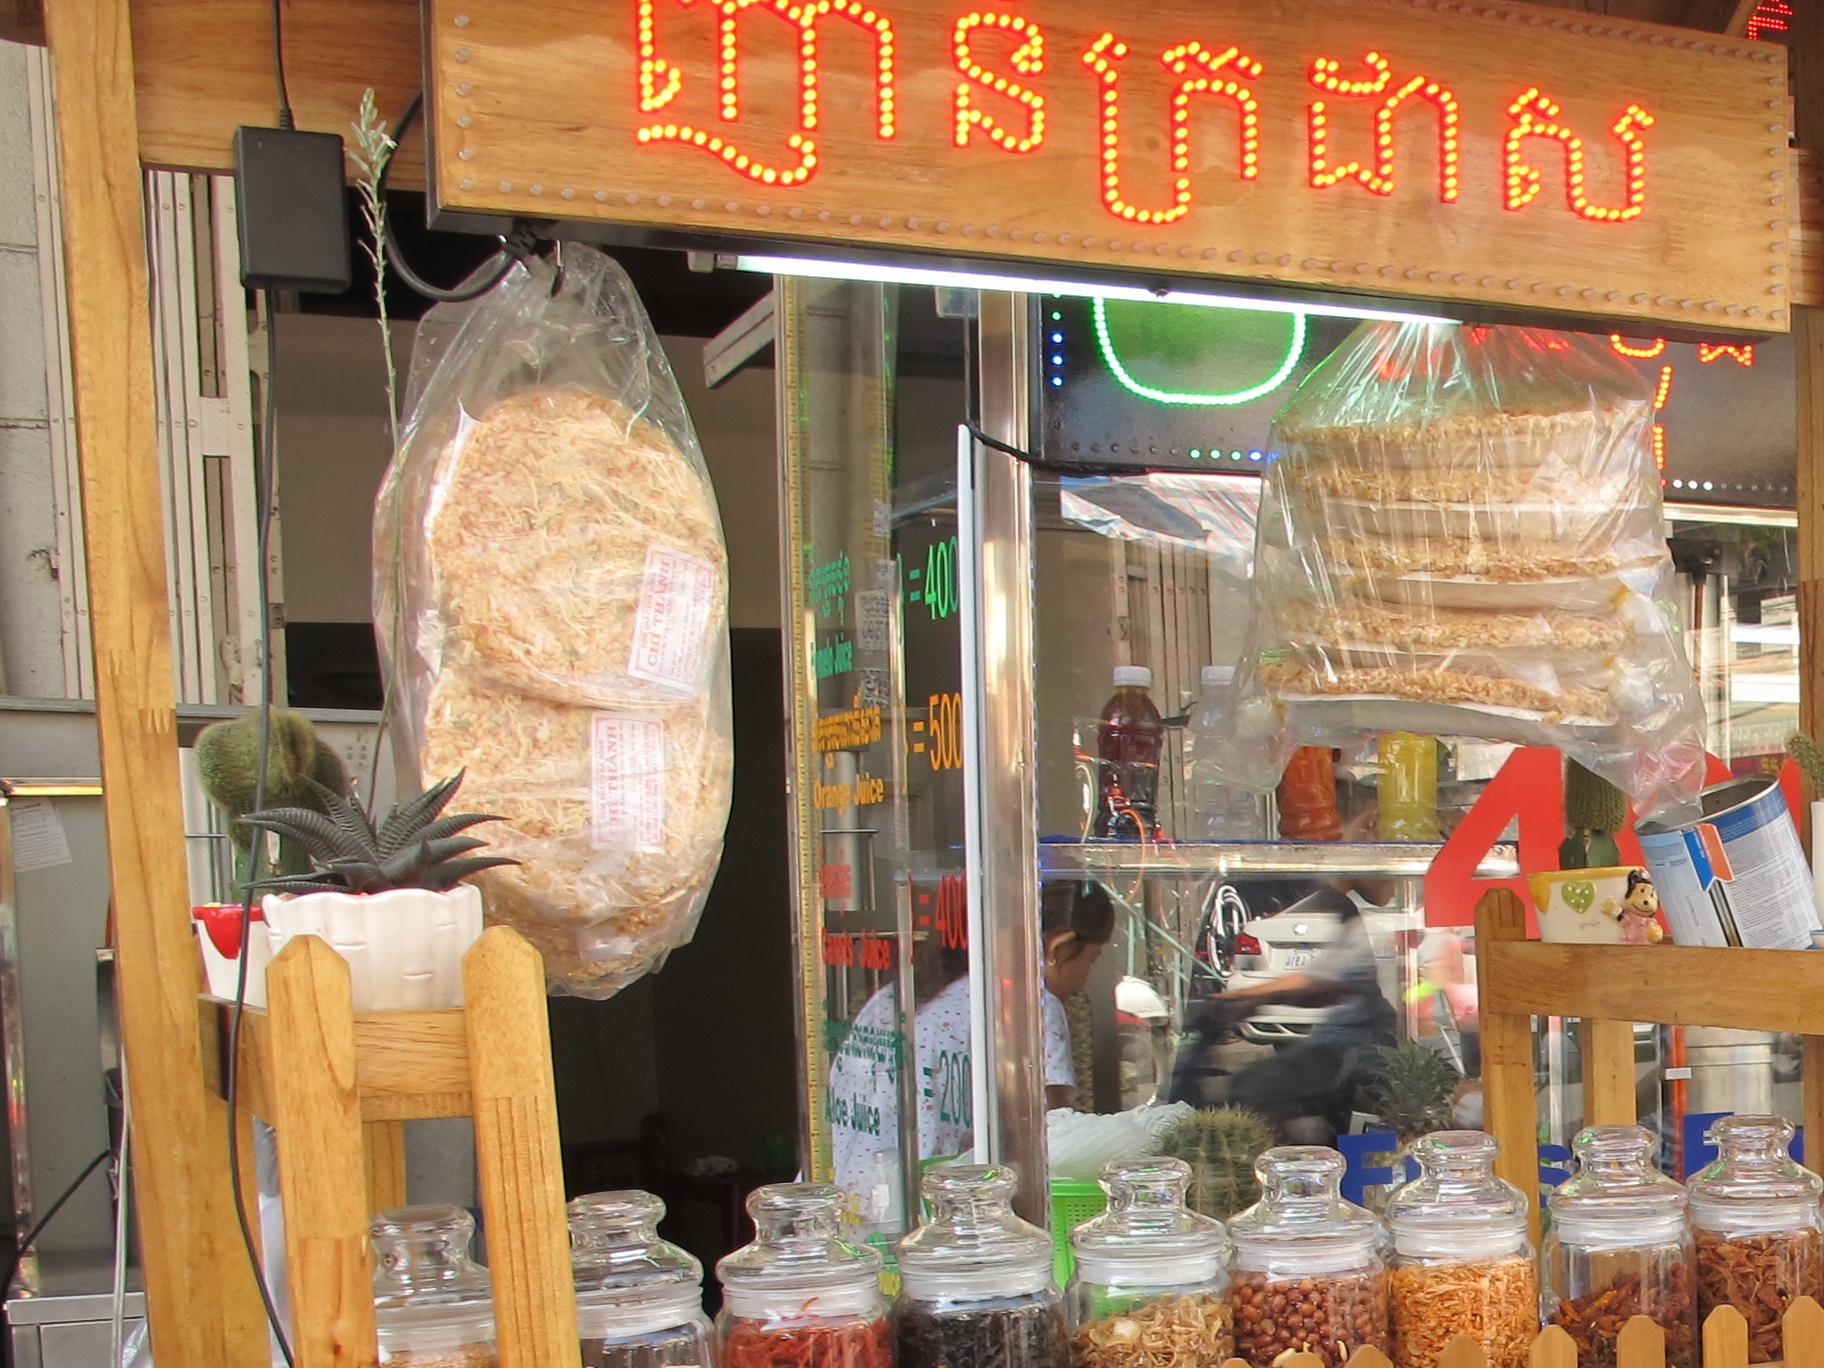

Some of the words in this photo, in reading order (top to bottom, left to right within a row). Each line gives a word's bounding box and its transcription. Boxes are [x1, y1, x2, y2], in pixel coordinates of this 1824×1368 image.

[812, 778, 851, 816] Orange
[853, 771, 885, 807] Juice
[859, 929, 891, 971] Juice
[824, 1086, 848, 1128] Aloe
[850, 1091, 880, 1137] Juice
